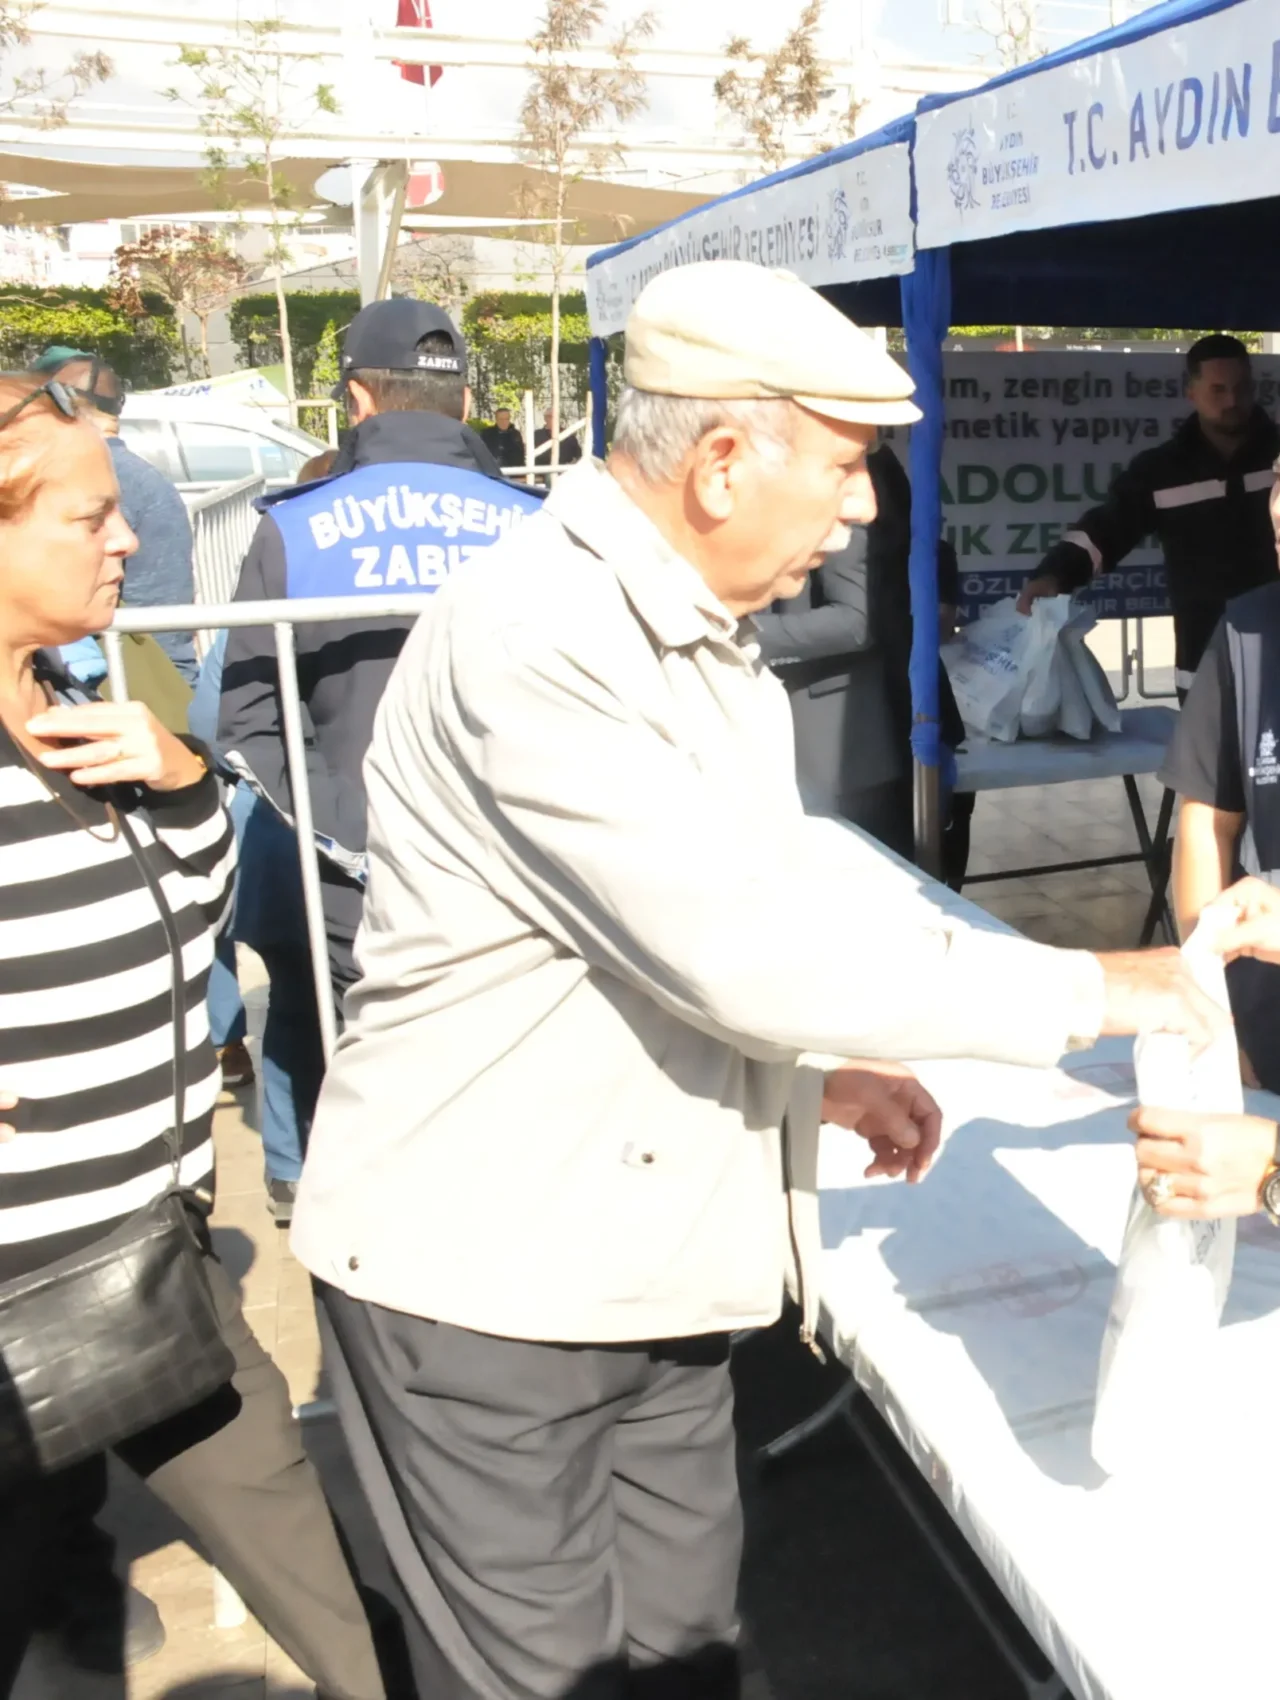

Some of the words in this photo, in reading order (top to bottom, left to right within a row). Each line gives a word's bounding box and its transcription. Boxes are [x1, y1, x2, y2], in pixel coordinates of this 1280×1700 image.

[1063, 102, 1118, 175] T.C.
[1129, 62, 1252, 162] AYDIN
[417, 355, 458, 369] ZABITA
[1003, 371, 1113, 408] zengin
[1054, 413, 1160, 445] yapıya
[309, 485, 536, 550] BÜYÜKŞEHİ
[962, 574, 1029, 596] ÖZL
